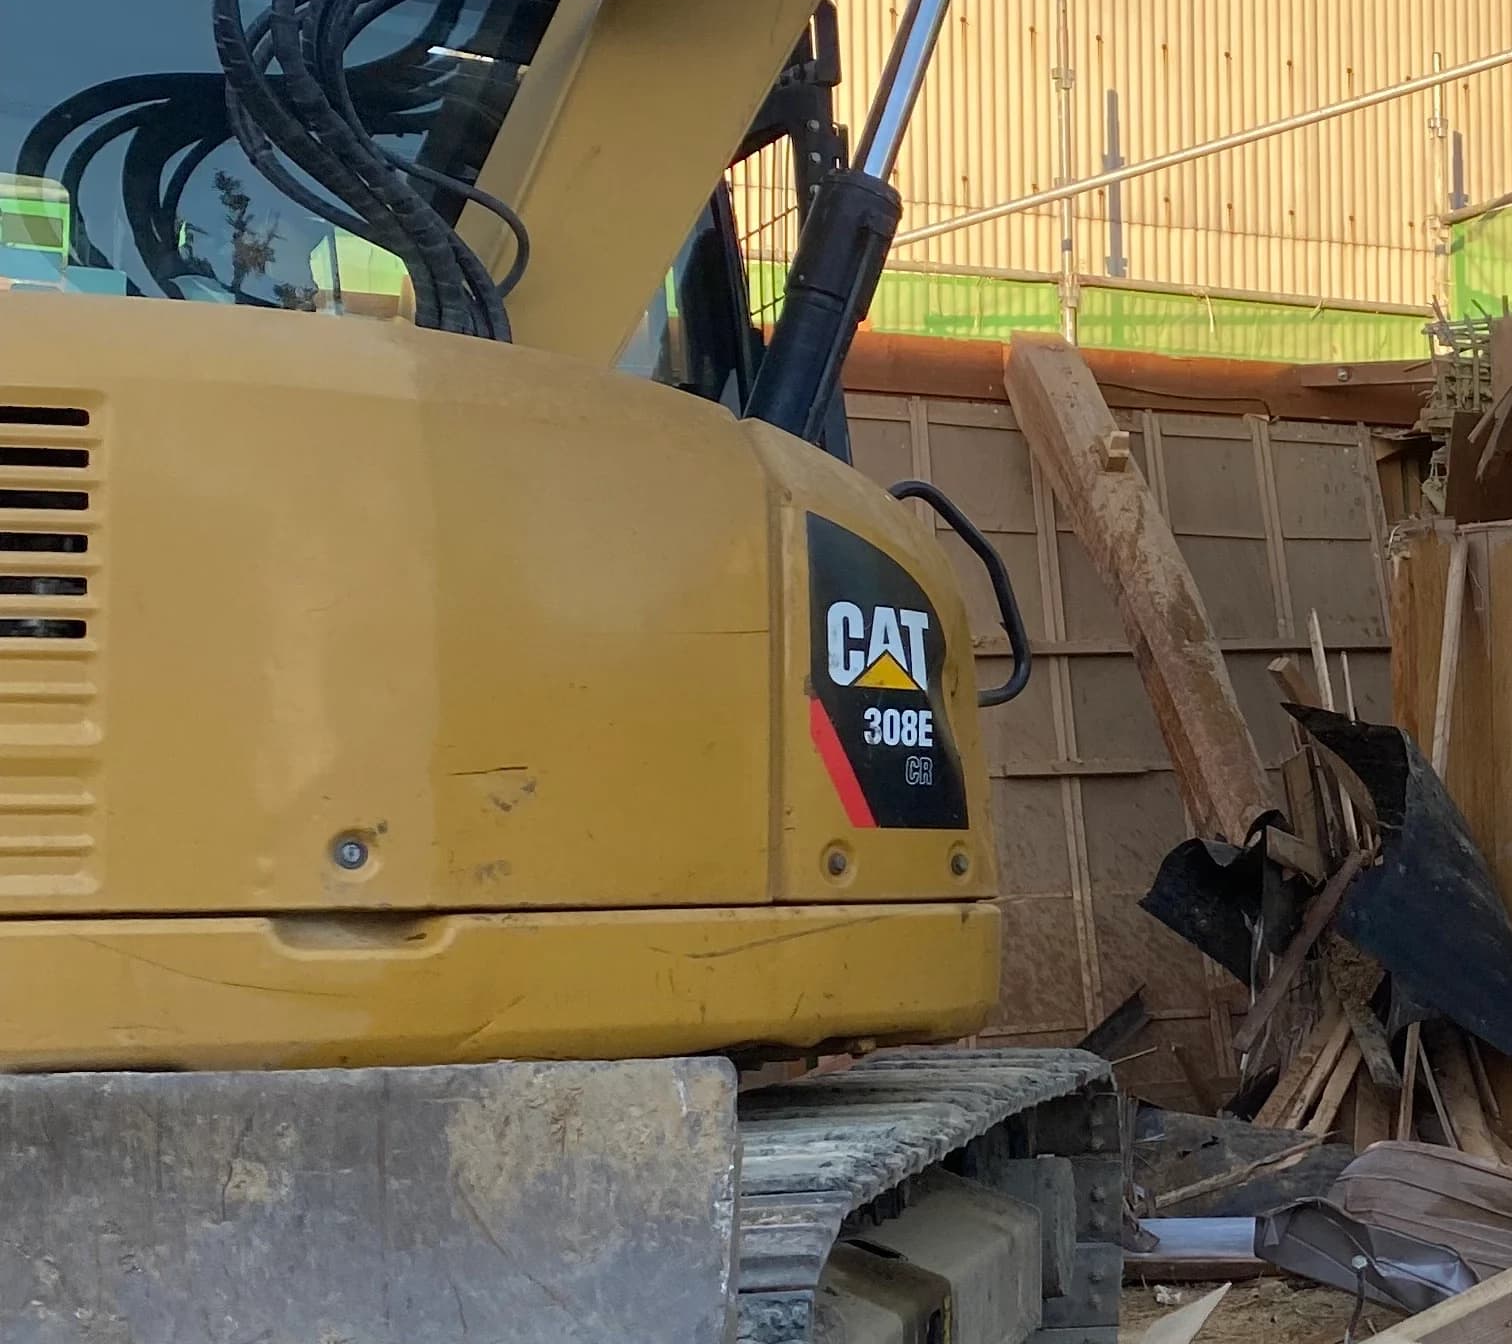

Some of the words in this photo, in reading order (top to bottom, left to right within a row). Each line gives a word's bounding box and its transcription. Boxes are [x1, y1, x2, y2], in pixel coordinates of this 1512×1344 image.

[827, 601, 929, 692] CAT
[863, 707, 933, 747] 308E
[905, 755, 933, 785] CR
